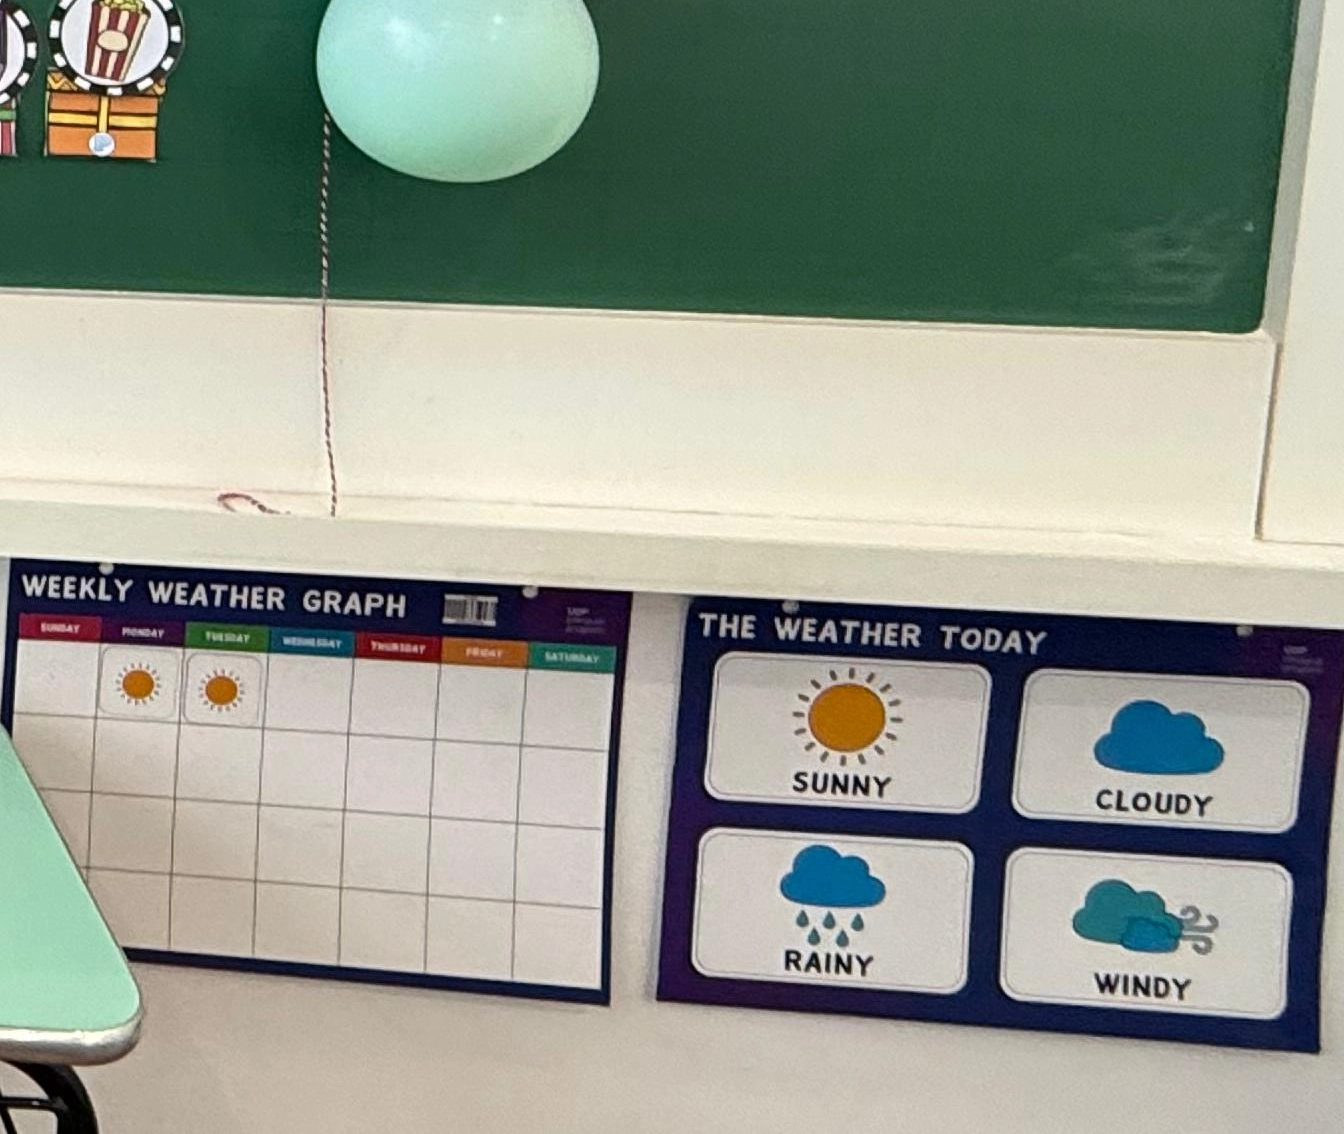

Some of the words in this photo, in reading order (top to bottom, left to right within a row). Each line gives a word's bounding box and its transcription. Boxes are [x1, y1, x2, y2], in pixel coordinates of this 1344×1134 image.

[21, 573, 134, 603] WEEKLY
[148, 580, 286, 611] WEATHER
[302, 588, 407, 619] GRAPH
[39, 621, 81, 635] SUNDAY
[121, 626, 165, 640] MONDAY
[698, 612, 757, 640] THE
[774, 616, 922, 649] WEATHER
[939, 624, 1048, 656] TODAY
[205, 630, 251, 644] TUESDAY
[281, 635, 343, 650] WEDNESDAY
[370, 640, 427, 655] THURSDAY
[465, 647, 504, 660] FRIDAY
[544, 651, 600, 665] SATURDAY
[792, 770, 893, 800] SUNNY
[1095, 789, 1214, 818] CLOUDY
[783, 949, 875, 979] RAINY
[1094, 972, 1192, 1002] WINDY
